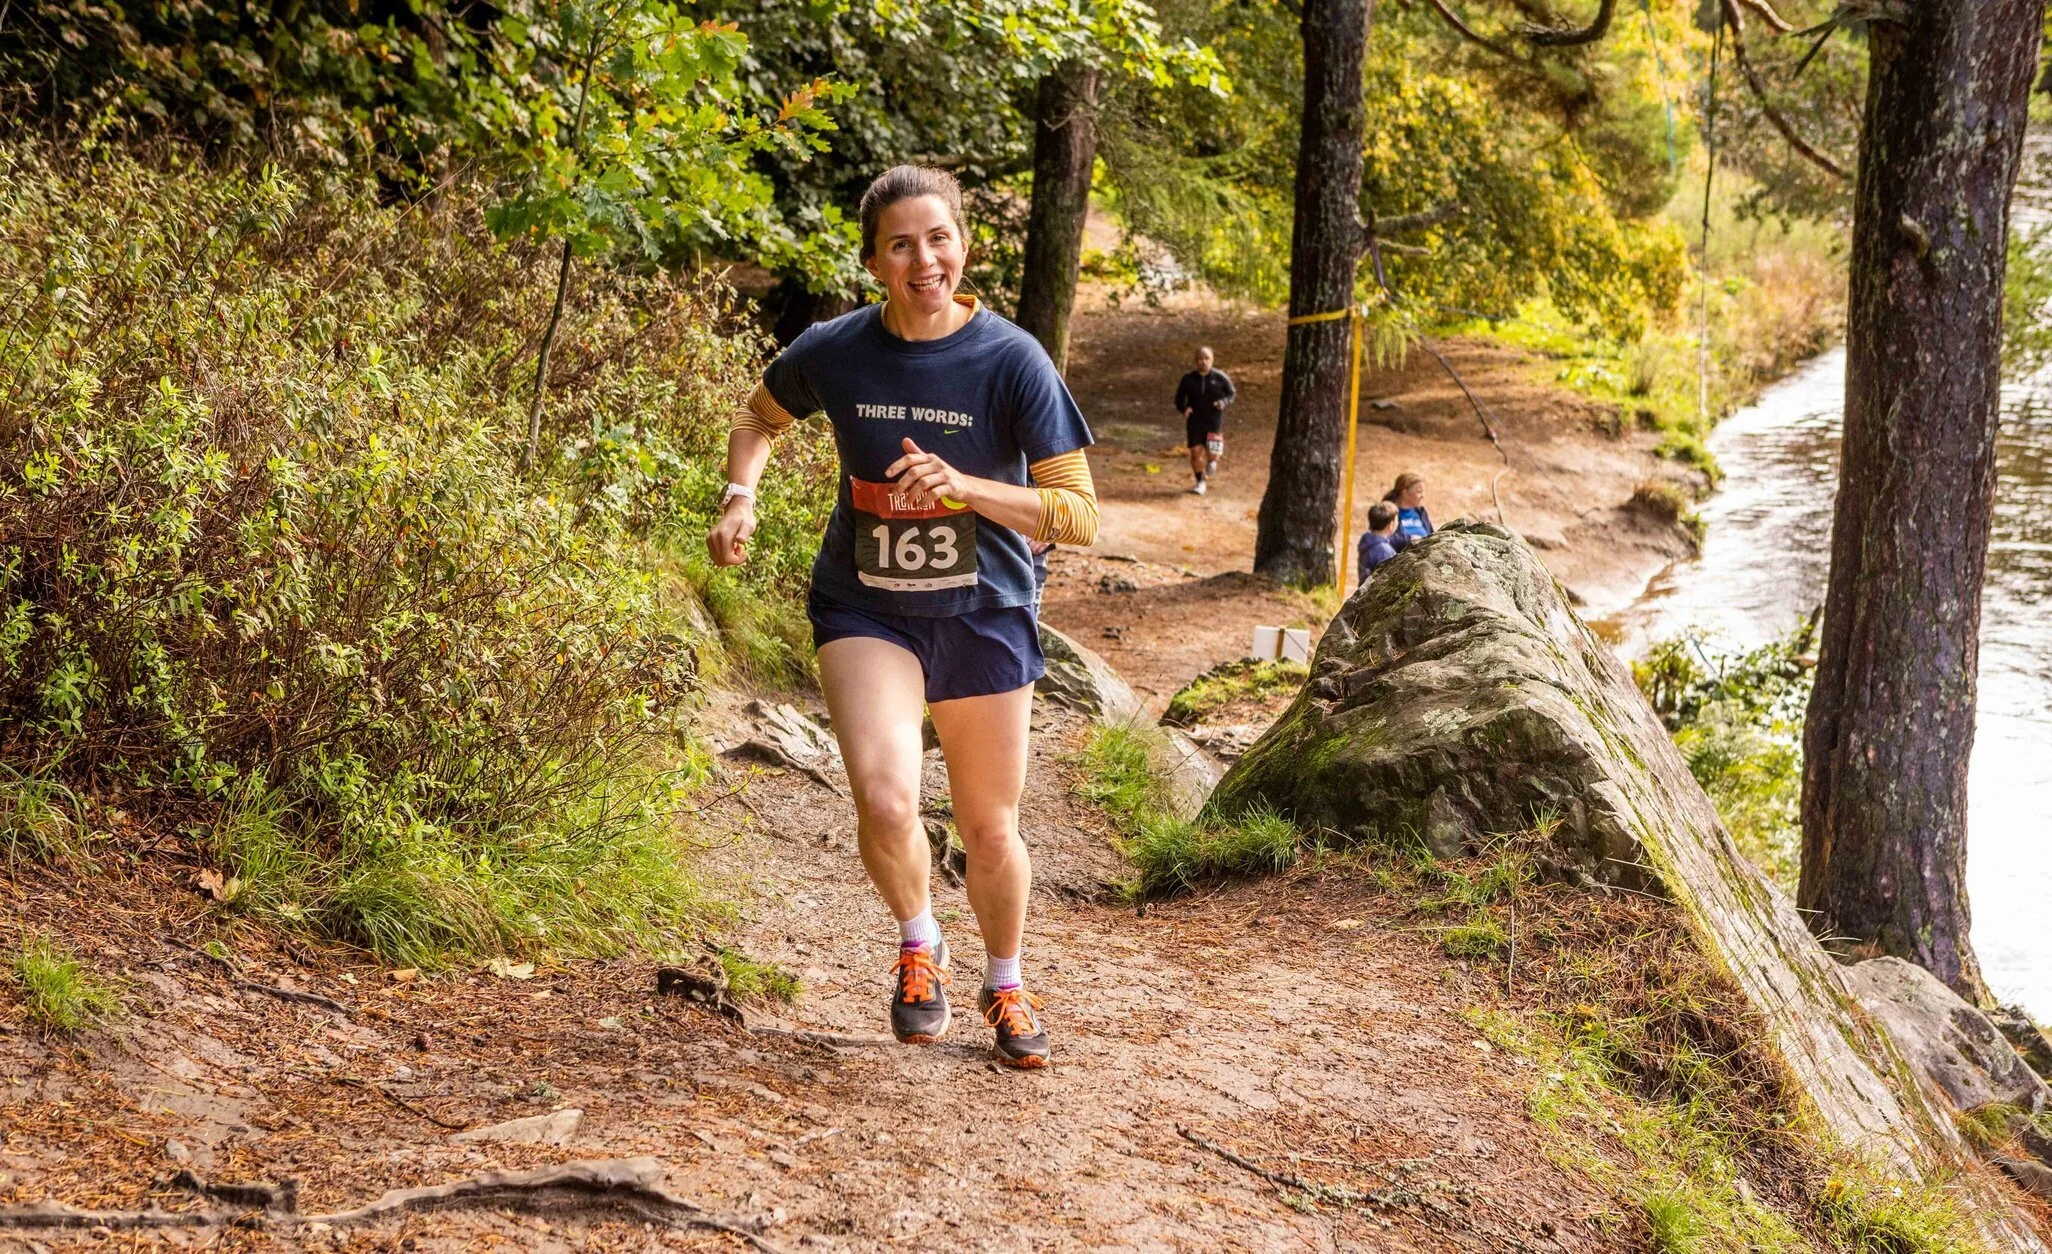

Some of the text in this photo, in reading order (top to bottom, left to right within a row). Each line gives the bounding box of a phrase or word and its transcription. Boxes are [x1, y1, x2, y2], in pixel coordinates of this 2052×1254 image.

[856, 404, 974, 427] THREE WORDS:
[872, 524, 959, 571] 163
